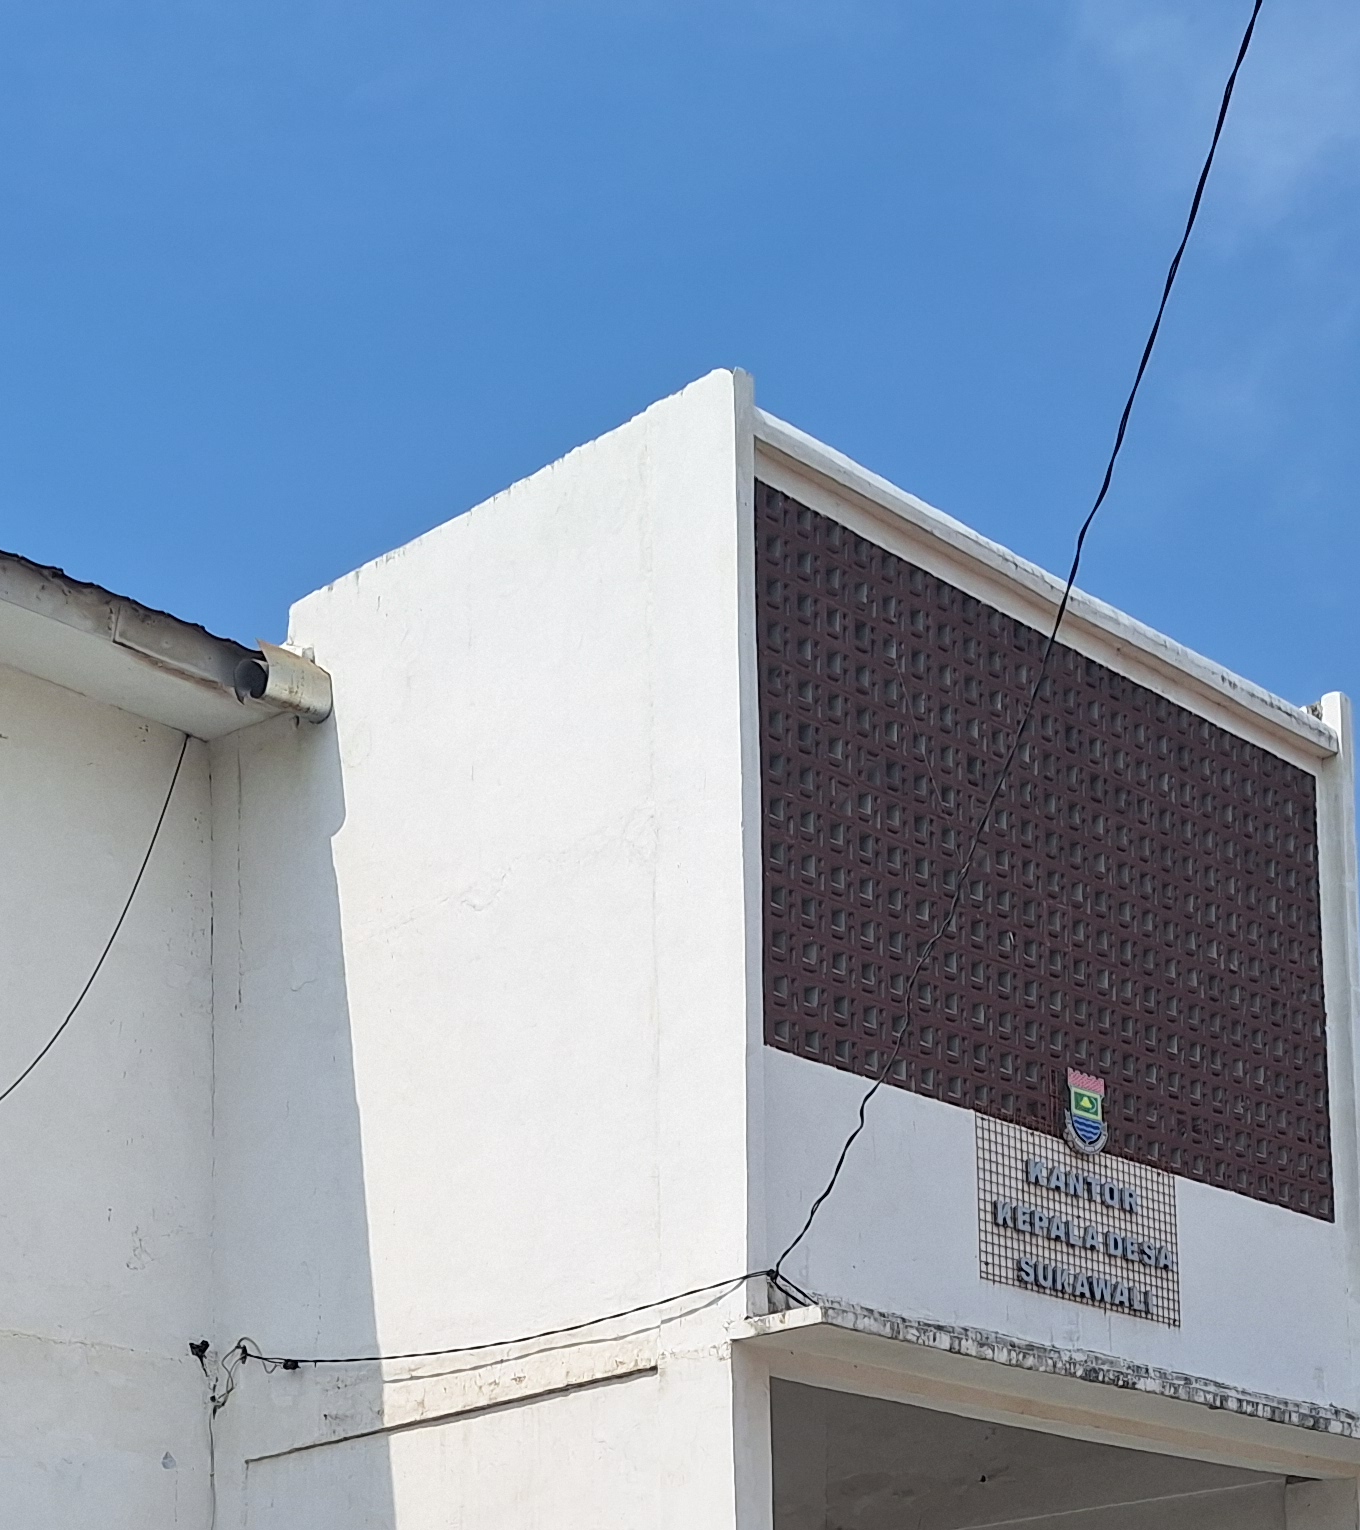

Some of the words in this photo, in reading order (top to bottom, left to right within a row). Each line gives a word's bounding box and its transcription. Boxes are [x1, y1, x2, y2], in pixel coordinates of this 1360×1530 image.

[1026, 1158, 1140, 1214] KANTOR
[994, 1199, 1101, 1251] KEPALA
[1105, 1231, 1175, 1271] DESA
[1017, 1257, 1154, 1314] SUKAWALI
